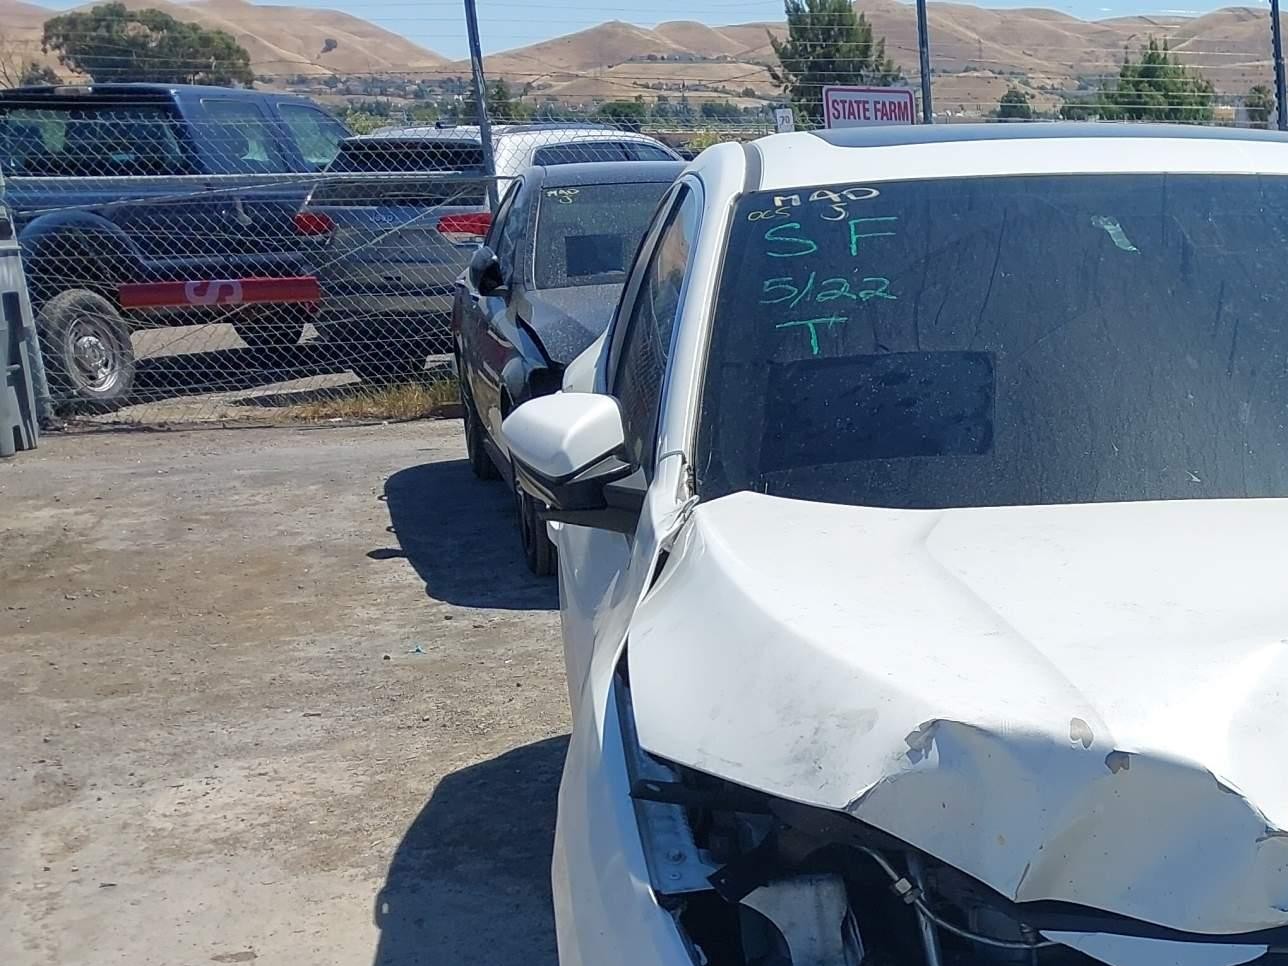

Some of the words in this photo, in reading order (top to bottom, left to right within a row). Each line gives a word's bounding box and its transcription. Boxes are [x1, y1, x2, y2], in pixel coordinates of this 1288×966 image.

[831, 99, 871, 121] STATE
[873, 100, 909, 122] FARM
[773, 187, 880, 207] MAD
[759, 271, 898, 309] 5/22
